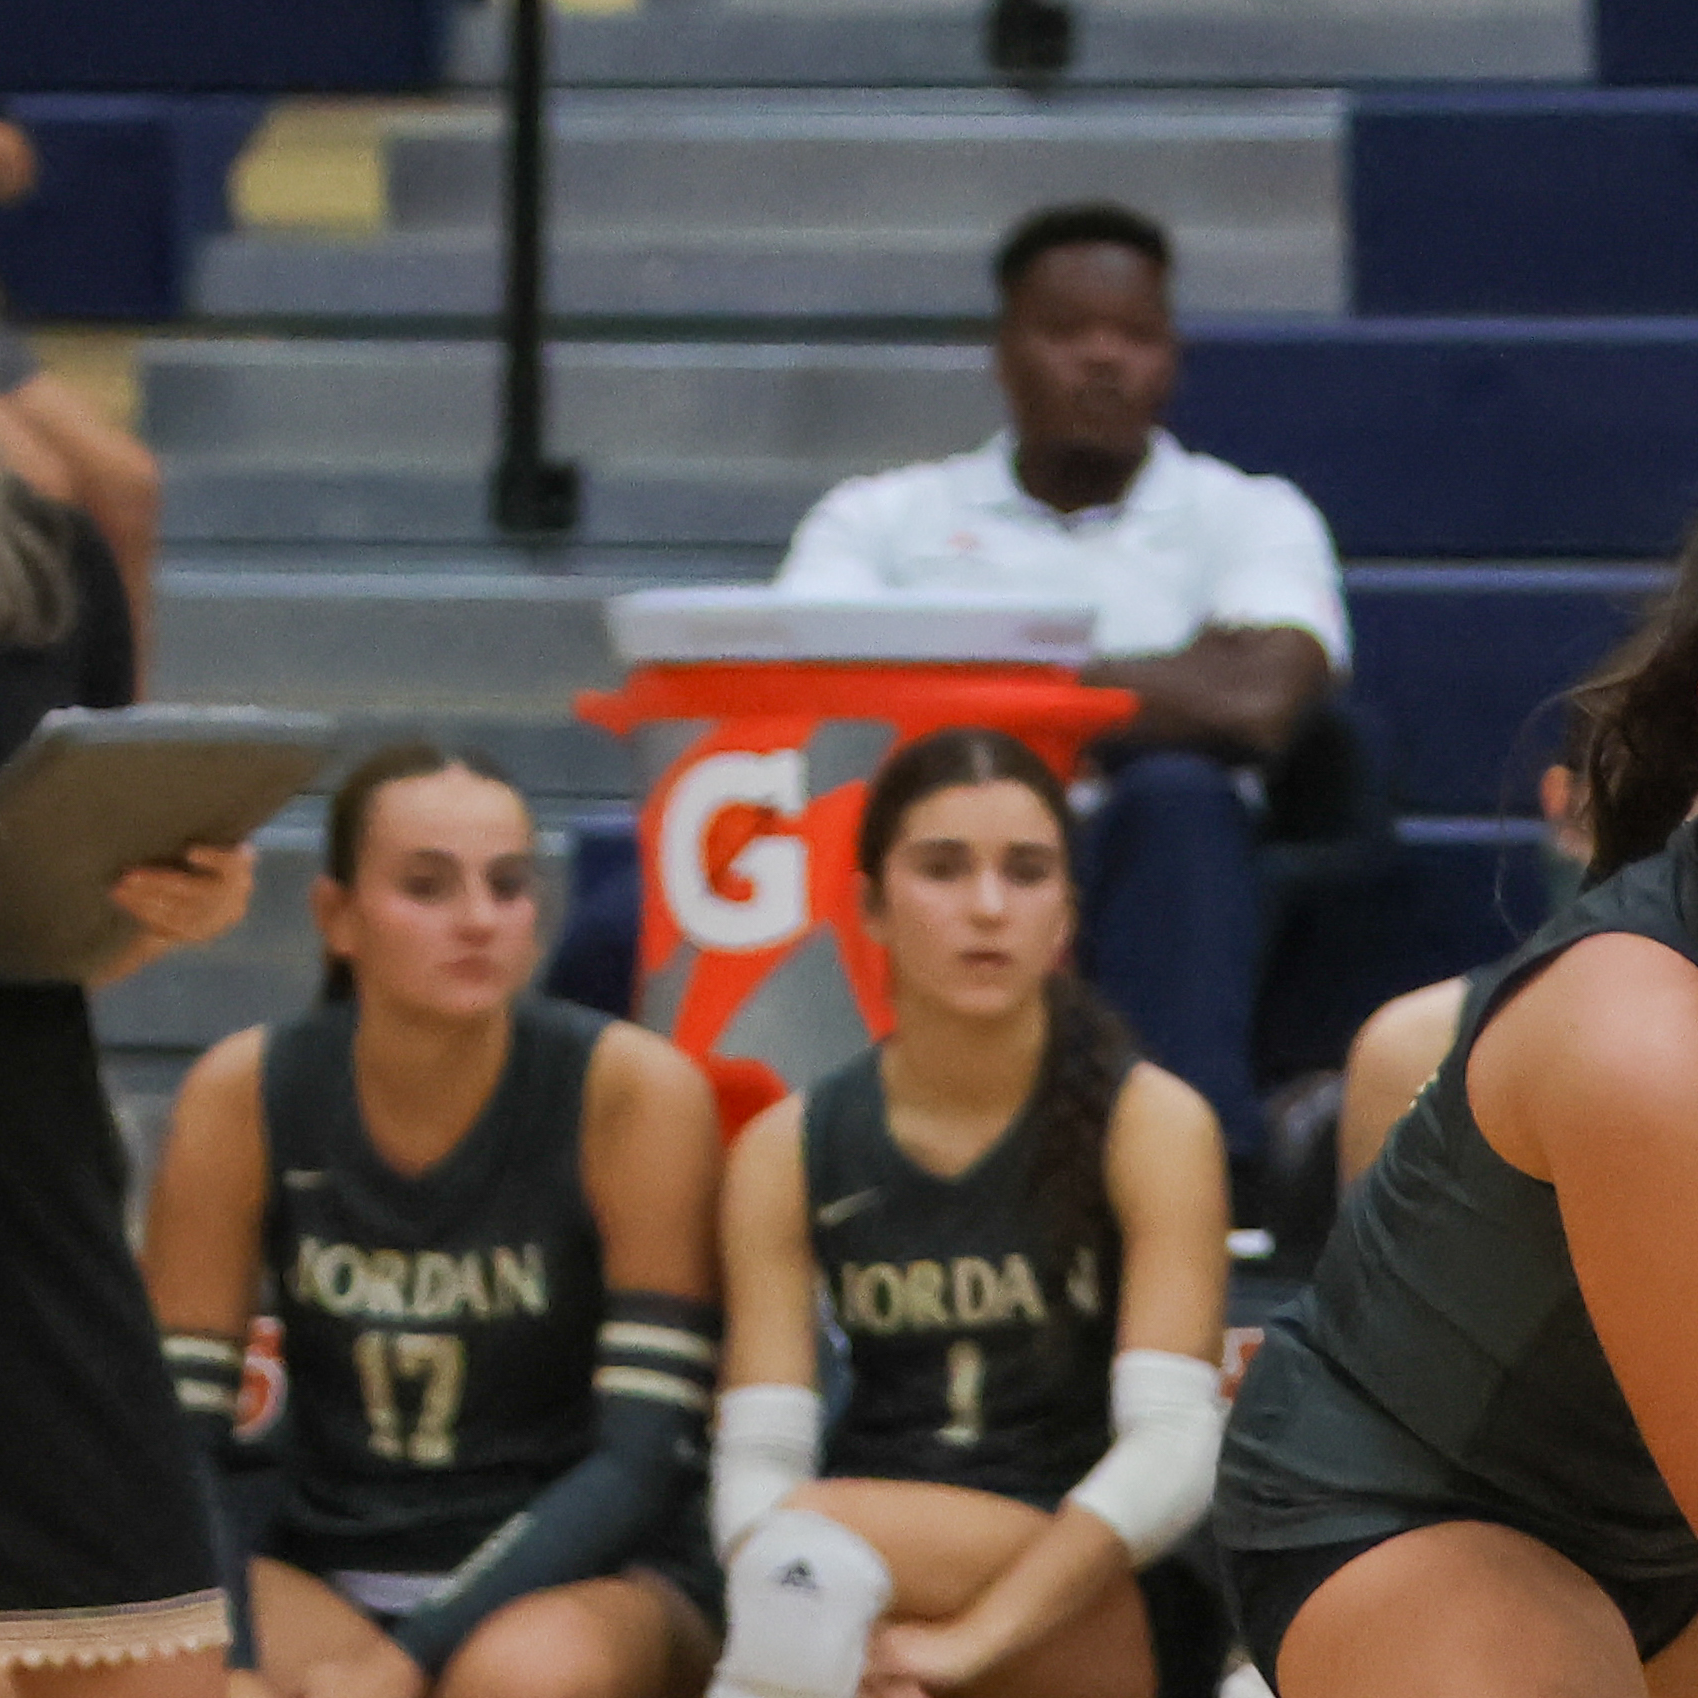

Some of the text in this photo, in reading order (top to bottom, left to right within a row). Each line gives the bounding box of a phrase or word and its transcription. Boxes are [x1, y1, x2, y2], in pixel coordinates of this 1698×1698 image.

[656, 748, 811, 951] G
[286, 1237, 549, 1317] JORDAN
[354, 1331, 465, 1466] 17
[933, 1338, 987, 1446] 1
